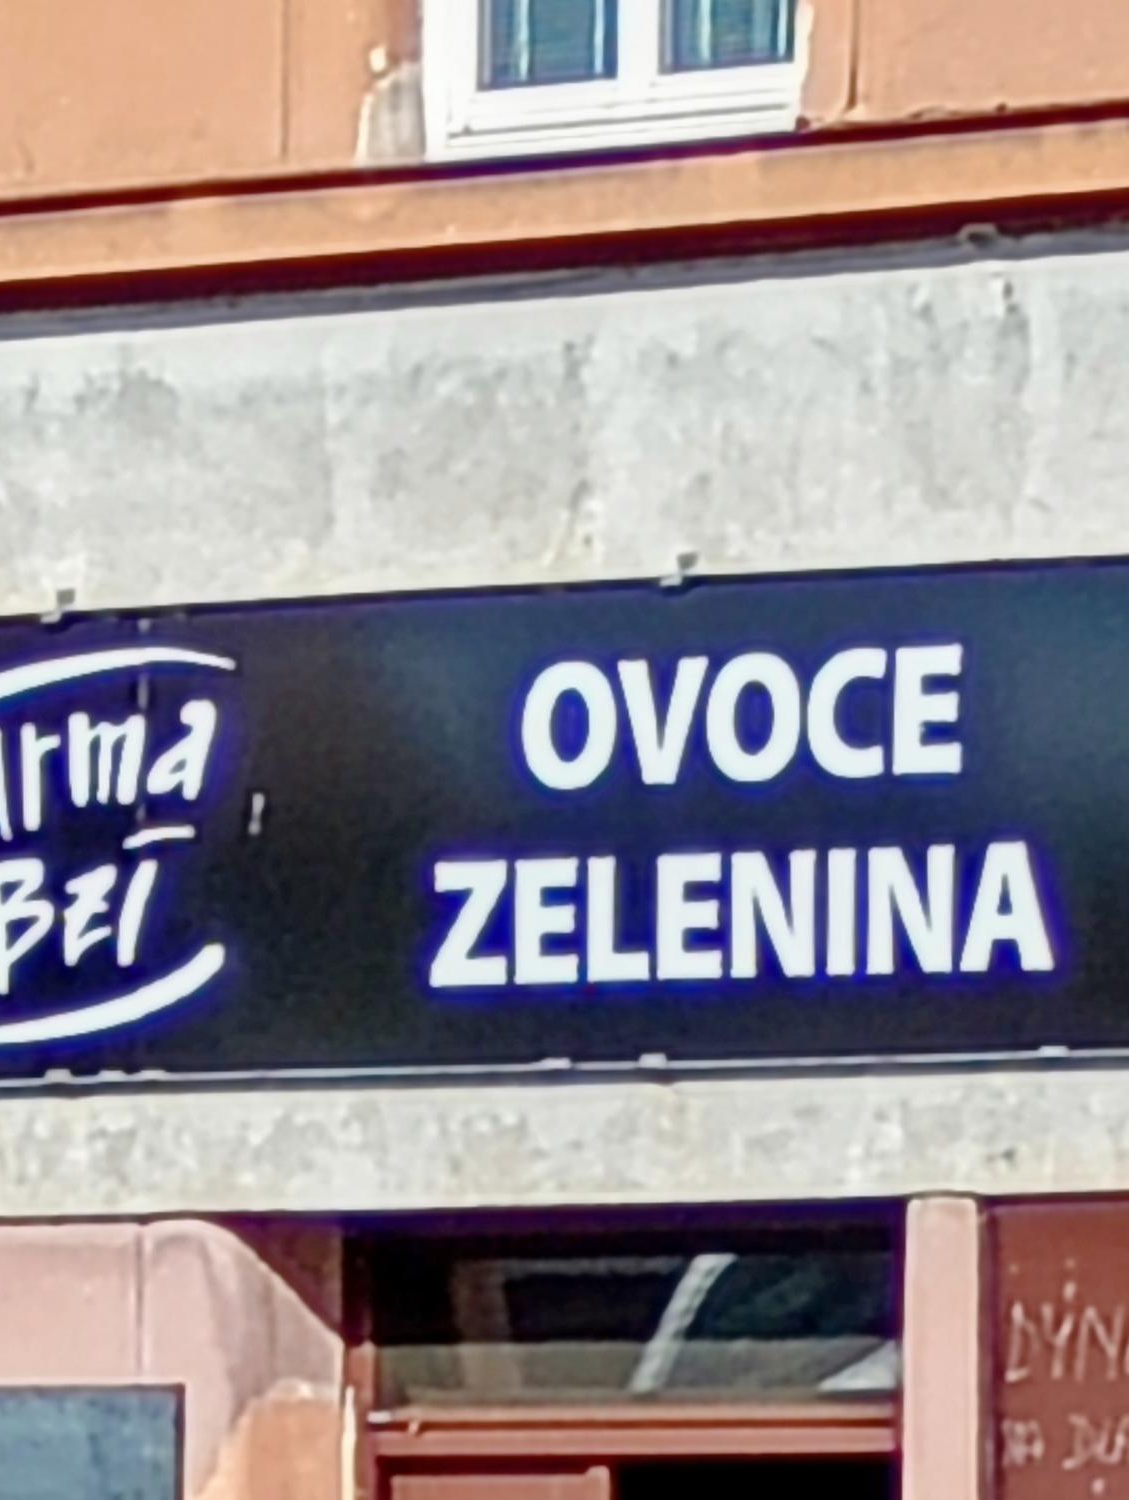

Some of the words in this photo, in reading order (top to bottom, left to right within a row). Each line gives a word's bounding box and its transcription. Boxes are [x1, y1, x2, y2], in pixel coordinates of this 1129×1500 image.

[522, 643, 963, 790] OVOCE
[428, 840, 1055, 988] ZELENINA
[1005, 1281, 1129, 1382] DÝN
